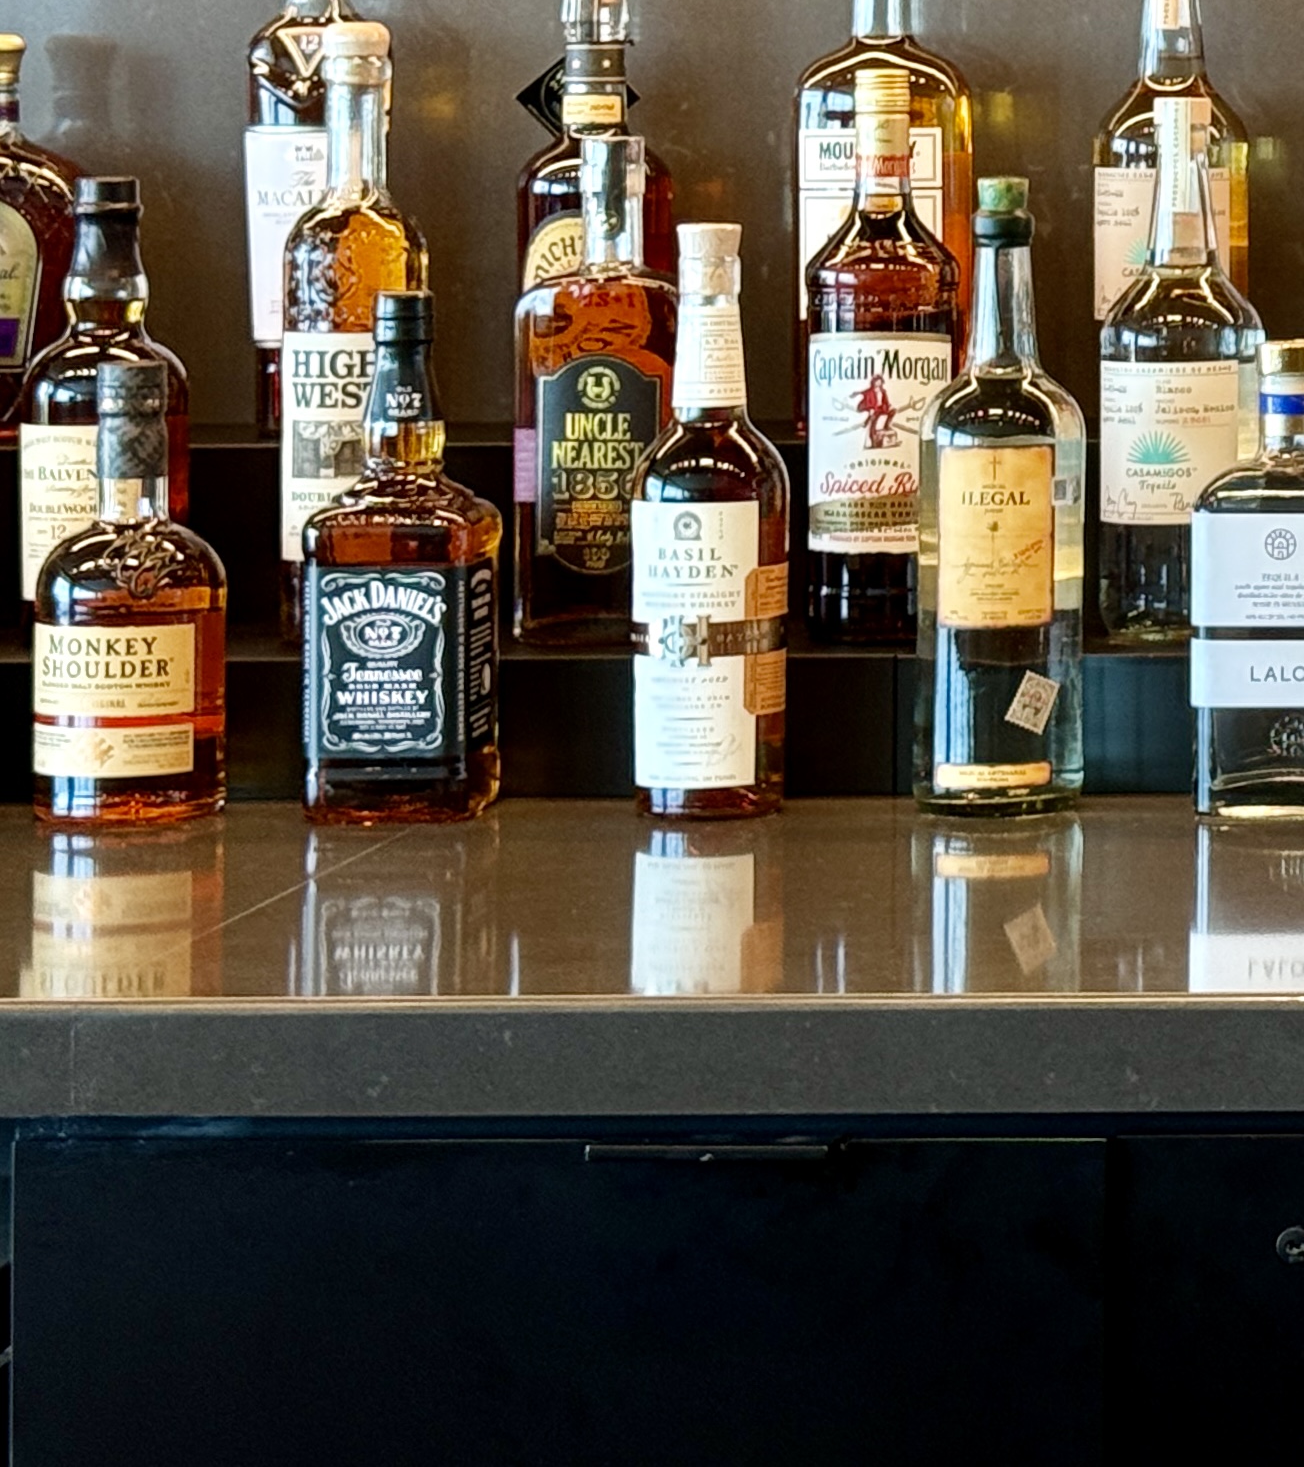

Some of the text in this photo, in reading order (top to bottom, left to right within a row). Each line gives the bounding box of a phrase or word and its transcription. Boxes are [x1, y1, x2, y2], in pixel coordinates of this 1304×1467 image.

[819, 141, 854, 160] MOU
[813, 349, 948, 386] Captain Morgan
[565, 413, 631, 440] UNCLE
[552, 441, 644, 469] NEAREST
[38, 465, 98, 482] BALVEN
[1126, 467, 1192, 478] CASAMIGOS
[820, 471, 919, 496] Spiced Ru
[962, 491, 1030, 506] ILEGAL
[658, 547, 722, 561] BASIL
[648, 564, 735, 579] HAYDEN
[321, 580, 447, 626] JACK DANIEL'S
[49, 633, 158, 657] MONKEY
[42, 655, 170, 679] SHOULDER
[342, 662, 424, 682] Tennessee
[336, 690, 429, 705] WHISKEY
